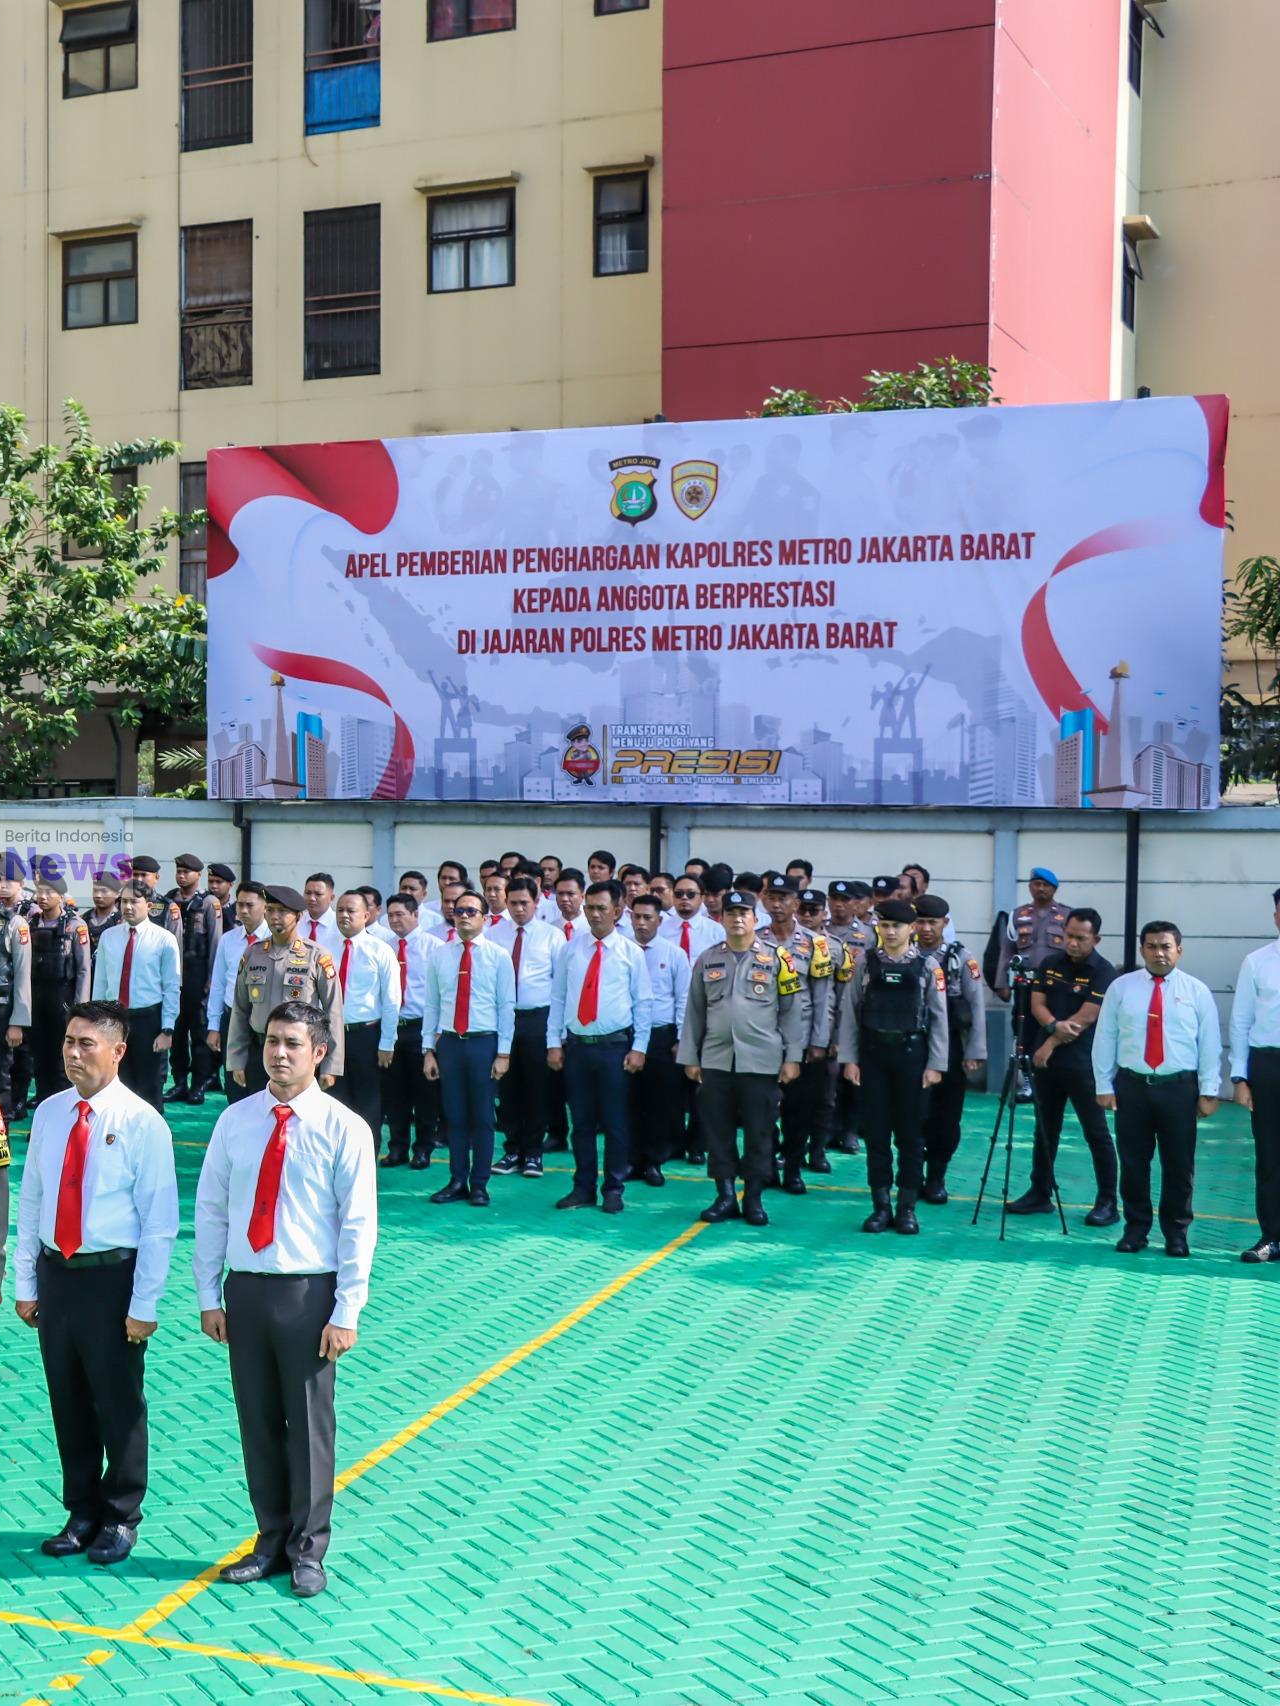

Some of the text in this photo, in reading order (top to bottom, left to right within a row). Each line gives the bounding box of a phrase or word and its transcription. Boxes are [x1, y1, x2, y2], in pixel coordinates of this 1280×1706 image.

[612, 458, 658, 468] METRO JAYA
[344, 532, 1036, 579] APEL PEMBERIAN PENGHARGAAN KAPOLRES METRO JAKARTA BARAT
[513, 580, 836, 614] KEPADA ANGGOTA BERPRESTASI
[457, 621, 898, 654] DI JAJARAN POLRES METRO JAKARTA BARAT
[611, 725, 690, 736] TRANSFORMASI
[612, 737, 715, 748] MENUJU POLRI YANG
[611, 750, 783, 775] PRESISI
